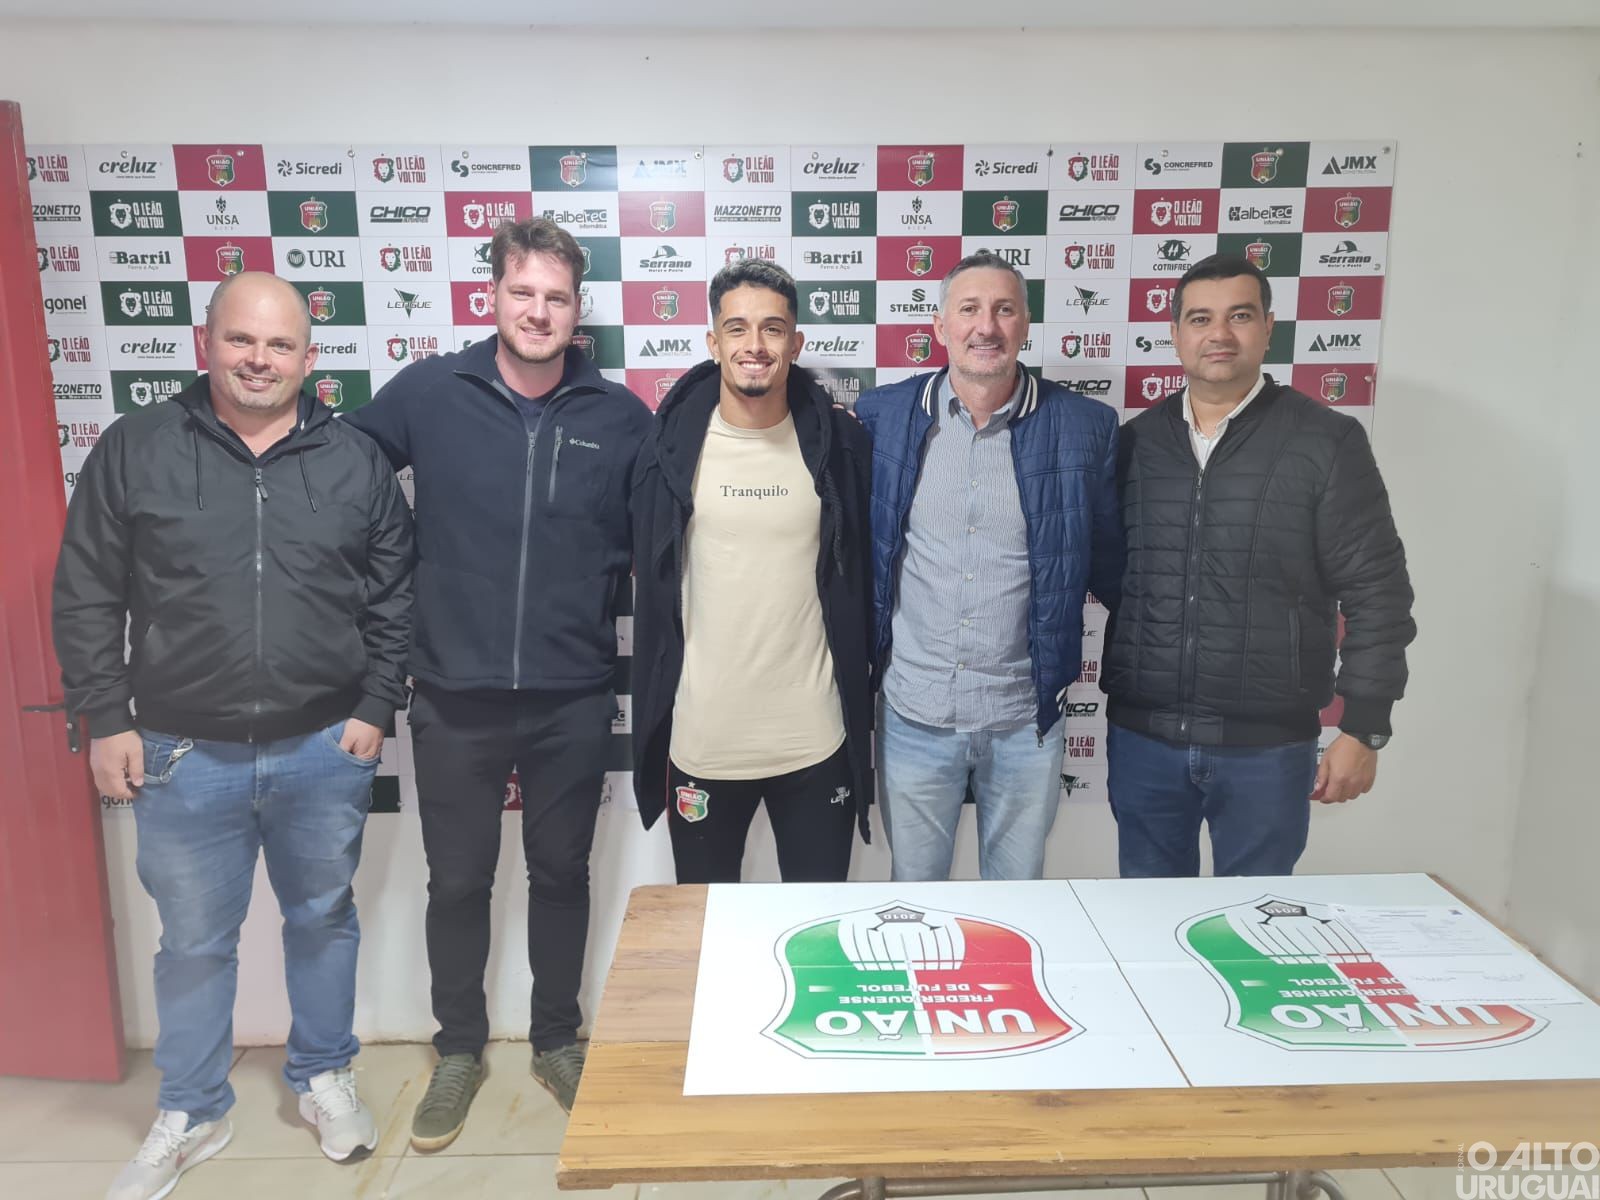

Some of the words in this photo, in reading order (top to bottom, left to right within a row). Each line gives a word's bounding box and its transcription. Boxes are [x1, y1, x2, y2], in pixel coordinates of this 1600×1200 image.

[38, 156, 44, 169] O
[47, 154, 68, 169] LEÃO
[99, 157, 157, 174] creluz
[396, 157, 402, 170] O
[404, 155, 425, 170] LEÃO
[746, 157, 751, 170] O
[754, 155, 774, 170] LEÃO
[804, 157, 860, 174] creluz
[1091, 156, 1096, 168] O
[1099, 154, 1119, 168] LEÃO
[1341, 156, 1377, 169] JMX
[296, 163, 342, 175] Sicredi
[992, 162, 1038, 174] Sicredi
[40, 170, 70, 182] VOLTOU
[397, 172, 426, 183] VOLTOU
[746, 172, 774, 183] VOLTOU
[1091, 170, 1118, 181] VOLTOU
[33, 205, 80, 215] ZONETTO
[133, 203, 140, 215] O
[141, 201, 163, 215] LEÃO
[370, 207, 431, 217] CHICO
[486, 203, 492, 216] O
[495, 201, 515, 217] LEÃO
[714, 205, 782, 215] MAZZONETTO
[832, 203, 838, 215] O
[840, 201, 859, 215] LEÃO
[1060, 205, 1120, 216] CHICO
[1174, 200, 1180, 213] O
[1182, 199, 1202, 213] LEÃO
[556, 210, 607, 223] albetec
[1241, 205, 1293, 220] albetec
[135, 217, 164, 228] VOLTOU
[207, 215, 239, 225] UNSA
[832, 217, 859, 228] VOLTOU
[901, 215, 932, 224] UNSA
[1174, 215, 1201, 226] VOLTOU
[50, 247, 55, 259] O
[58, 244, 78, 259] LEÃO
[402, 247, 408, 259] O
[412, 245, 431, 259] LEÃO
[748, 247, 753, 258] O
[755, 244, 774, 258] LEÃO
[1088, 244, 1092, 257] O
[1095, 243, 1115, 257] LEÃO
[117, 251, 171, 264] Barril
[309, 250, 346, 267] URI
[811, 251, 862, 264] Barril
[1088, 258, 1114, 269] VOLTOU
[1319, 255, 1372, 264] Serrano
[52, 261, 80, 272] VOLTOU
[404, 261, 432, 272] VOLTOU
[640, 260, 692, 268] Serrano
[143, 291, 149, 304] O
[152, 289, 172, 304] LEÃO
[832, 291, 837, 304] O
[840, 289, 859, 304] LEÃO
[144, 305, 173, 316] VOLTOU
[832, 304, 859, 315] VOLTOU
[890, 304, 938, 312] STEMETA
[62, 338, 67, 350] O
[70, 336, 89, 350] LEÃO
[410, 337, 415, 349] O
[418, 336, 438, 349] LEÃO
[805, 336, 858, 352] creluz
[1084, 334, 1089, 346] O
[1092, 332, 1110, 346] LEÃO
[1327, 334, 1361, 346] JMX
[121, 338, 176, 353] creluz
[658, 340, 691, 352] JMX
[64, 352, 91, 362] VOLTOU
[1084, 348, 1110, 358] VOLTOU
[153, 381, 159, 394] O
[161, 379, 181, 395] LEÃO
[1165, 376, 1171, 388] O
[53, 384, 101, 394] ZONETTO
[72, 423, 77, 435] O
[80, 422, 99, 435] LEÃO
[720, 485, 788, 500] Tranquilo
[1069, 737, 1074, 747] O
[1077, 736, 1095, 747] LEÃO
[1069, 748, 1094, 757] VOLTOU
[856, 984, 940, 993] FUTEBOL
[942, 984, 970, 992] DE
[1270, 1003, 1502, 1033] UNIÃO
[815, 1009, 1038, 1040] UNIÃO
